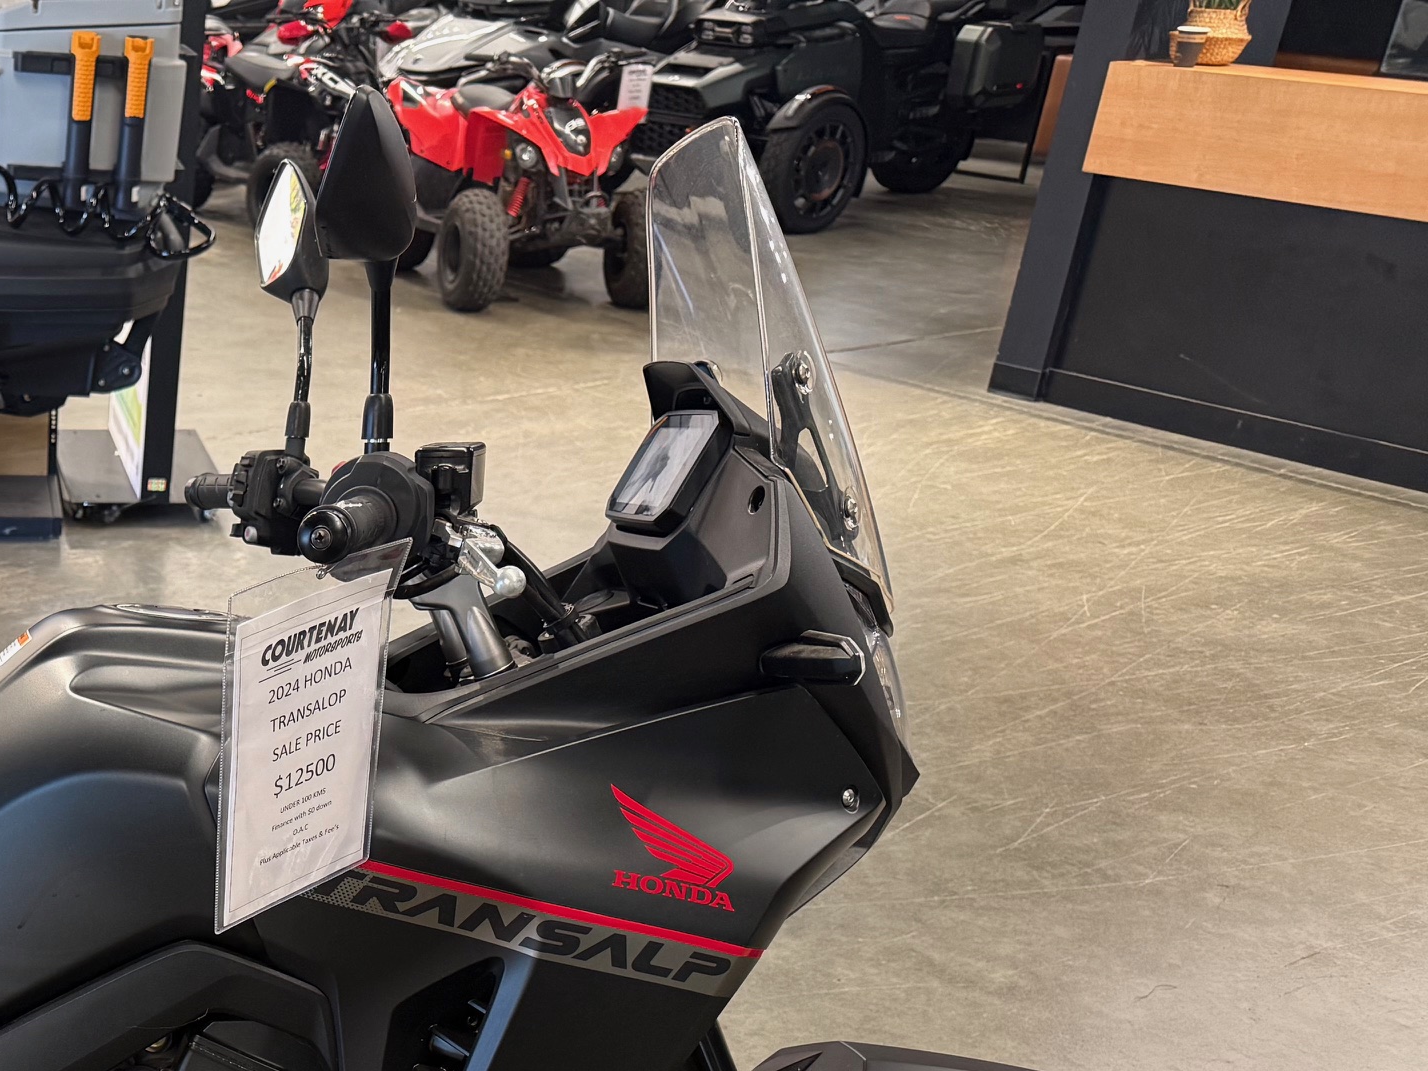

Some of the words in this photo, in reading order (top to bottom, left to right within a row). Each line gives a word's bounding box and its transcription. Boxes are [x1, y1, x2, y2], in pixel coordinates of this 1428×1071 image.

[261, 607, 360, 667] COURTENAY
[303, 629, 363, 664] MOTORSPORTS
[268, 678, 300, 704] 2024
[304, 656, 352, 689] HONDA
[270, 688, 347, 732] TRANSALOP
[272, 737, 302, 762] SALE
[305, 719, 342, 747] PRICE
[273, 753, 336, 799] $12500
[272, 817, 293, 832] Finance
[294, 811, 306, 822] with
[316, 800, 332, 812] down
[280, 800, 300, 814] UNDER
[301, 794, 313, 805] 100
[313, 788, 326, 799] KMS
[259, 856, 272, 866] Plus
[272, 841, 301, 860] Applicable
[302, 833, 318, 845] Taxes
[613, 869, 735, 912] HONDA
[310, 869, 732, 983] TRANSALP
